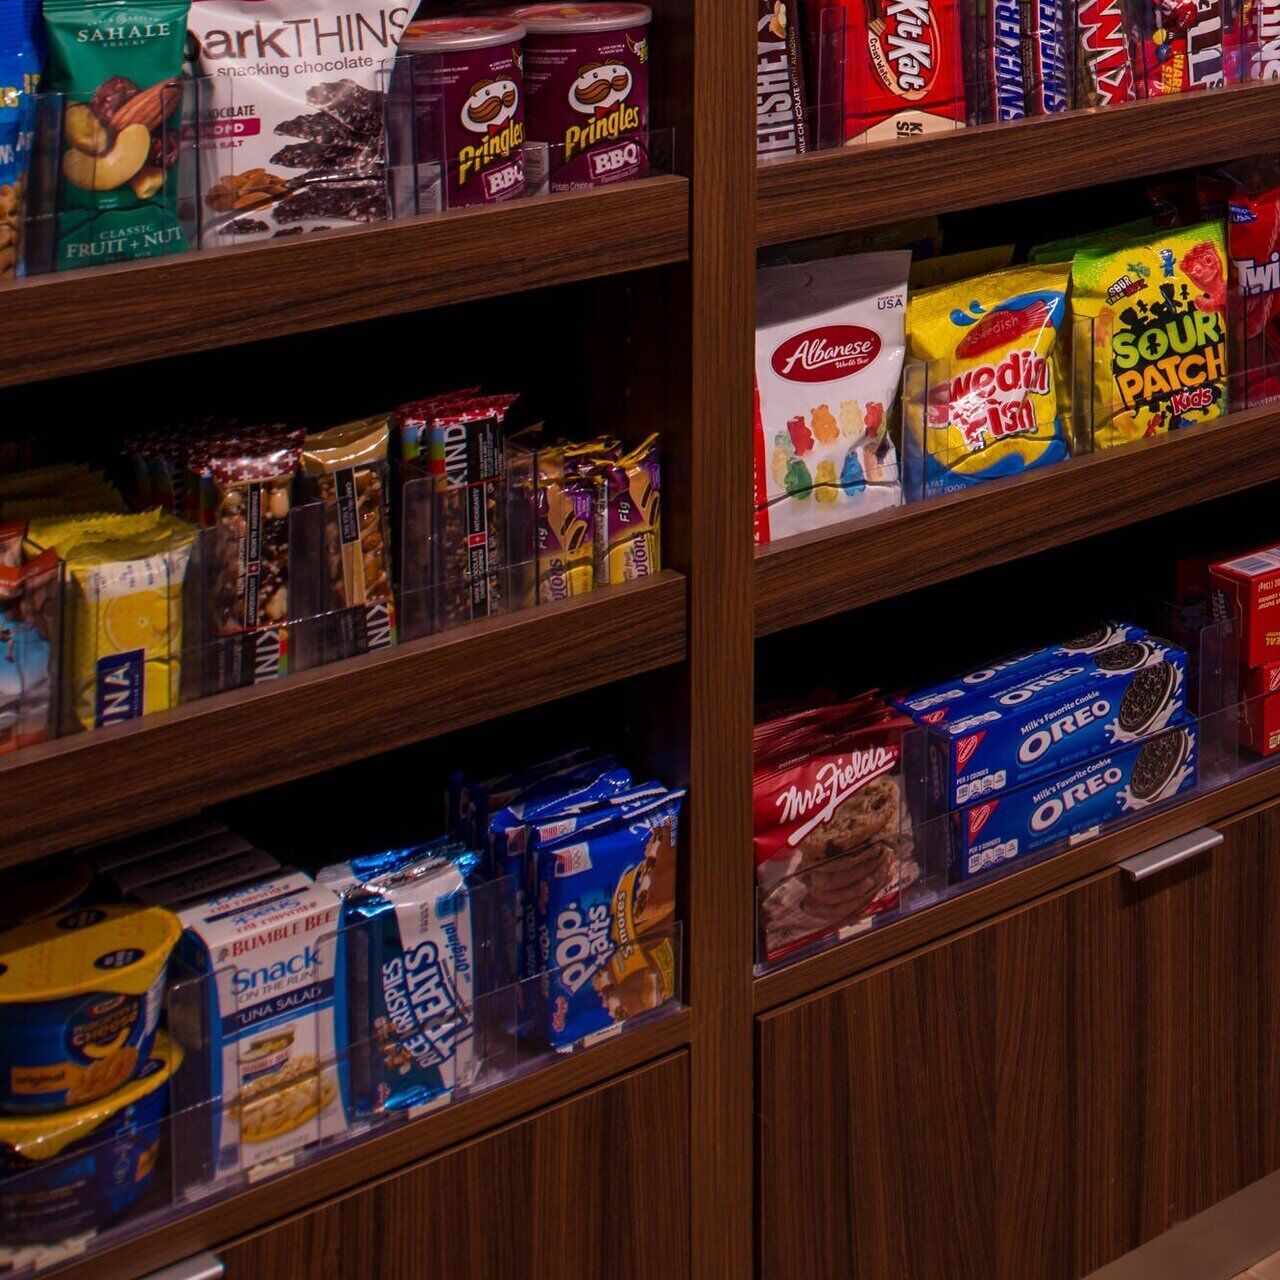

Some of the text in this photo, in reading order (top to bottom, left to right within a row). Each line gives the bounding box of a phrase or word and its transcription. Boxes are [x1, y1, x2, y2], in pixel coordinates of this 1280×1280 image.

[77, 23, 172, 44] SAHALE
[217, 55, 374, 78] snacking chocolate
[869, 37, 893, 88] Crisp Wafers
[459, 119, 525, 186] Pringles
[565, 105, 640, 163] Pringles
[593, 143, 638, 173] BBQ
[66, 226, 183, 259] FRUIT NUT
[100, 223, 155, 241] CLASSIC
[876, 298, 904, 311] USA
[1108, 276, 1132, 296] SOUR
[780, 338, 875, 375] Albanese
[1112, 310, 1219, 369] SOUR
[1117, 344, 1226, 408] PATCH
[1170, 388, 1213, 416] Kids
[444, 423, 468, 488] KIND
[619, 500, 631, 524] Fig
[537, 527, 549, 550] Fig
[998, 665, 1086, 707] OREO
[1018, 699, 1110, 766] OREO
[1020, 690, 1100, 735] Milk's Favorite Cookie
[776, 747, 898, 823] Mrs. Fields
[1029, 766, 1123, 832] OREO
[1032, 757, 1112, 804] Milk's Favorite Cookie
[232, 910, 335, 958] BUMBLE BEE
[442, 922, 470, 973] Original
[616, 891, 632, 959] S'mores
[230, 945, 321, 997] Snack
[260, 972, 315, 997] THE RUN
[276, 988, 322, 1012] SALAD
[404, 940, 471, 1057] TREATS
[15, 1069, 67, 1088] original
